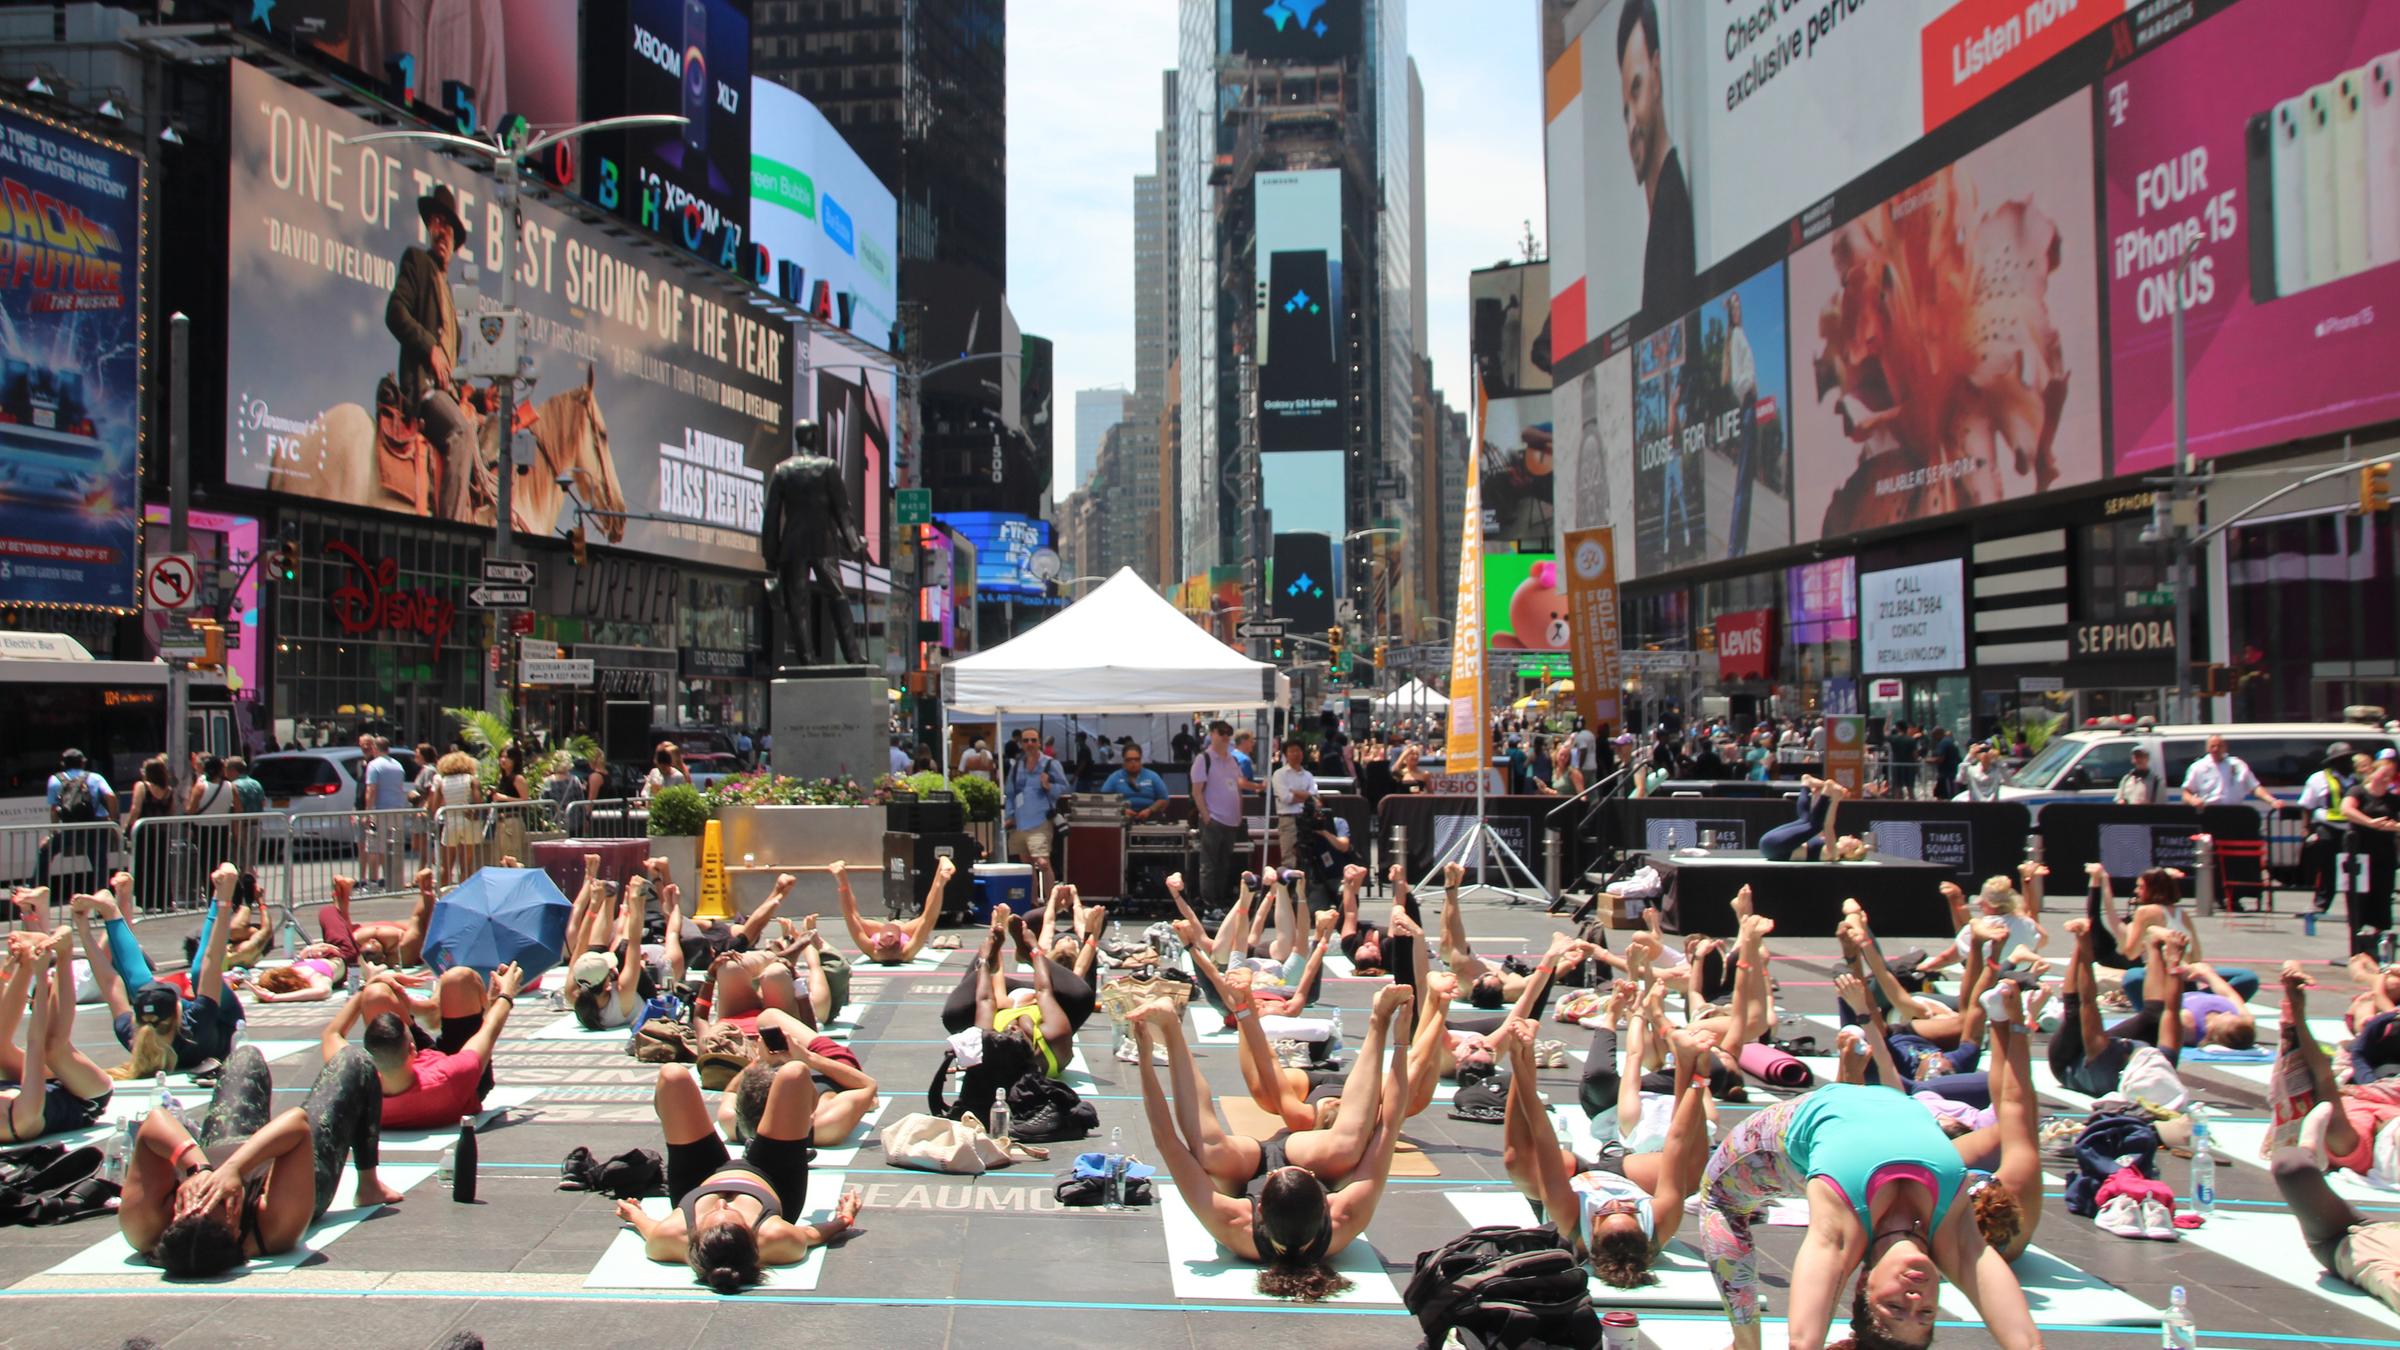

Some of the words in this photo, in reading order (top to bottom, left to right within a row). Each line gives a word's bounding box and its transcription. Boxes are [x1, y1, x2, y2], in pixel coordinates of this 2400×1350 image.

[633, 24, 681, 78] XBOOM
[1725, 0, 1777, 62] Check
[1952, 23, 2021, 86] Listen
[2026, 0, 2079, 38] now
[1727, 28, 1803, 112] exclusive
[717, 80, 739, 116] XL7
[7, 126, 38, 152] TIME
[39, 138, 58, 158] TO
[59, 146, 111, 178] CHANGE
[19, 149, 76, 182] THEATER
[77, 171, 128, 199] HISTORY
[2135, 145, 2209, 218] FOUR
[359, 146, 402, 232] OF
[413, 167, 475, 263] TE
[486, 201, 558, 294] BST
[565, 237, 650, 332] SHOWS
[657, 279, 685, 344] OF
[690, 293, 729, 364] THE
[2115, 215, 2200, 280] iPhone
[2204, 187, 2238, 244] 15
[11, 240, 122, 294] FUTURE
[325, 238, 397, 292] OYELOWO
[2136, 269, 2177, 325] ON
[2178, 255, 2215, 311] US
[720, 382, 744, 413] DAVID
[266, 432, 301, 462] FYC
[1641, 434, 1674, 472] LOOSE
[1682, 422, 1706, 454] FOR
[1715, 407, 1741, 444] LIFE
[660, 457, 704, 520] BASS
[705, 471, 765, 533] REEVES
[503, 591, 521, 600] WAY
[1896, 576, 1921, 595] CALL
[4, 638, 37, 650] Electric
[38, 640, 55, 650] Bus
[1597, 587, 1619, 690] SOLSTICE
[1892, 622, 1928, 638] CONTACT
[2078, 619, 2176, 653] SEPHORA
[707, 652, 725, 666] POLO
[1926, 843, 1966, 854] SQUARE
[1929, 832, 1963, 842] TIMES
